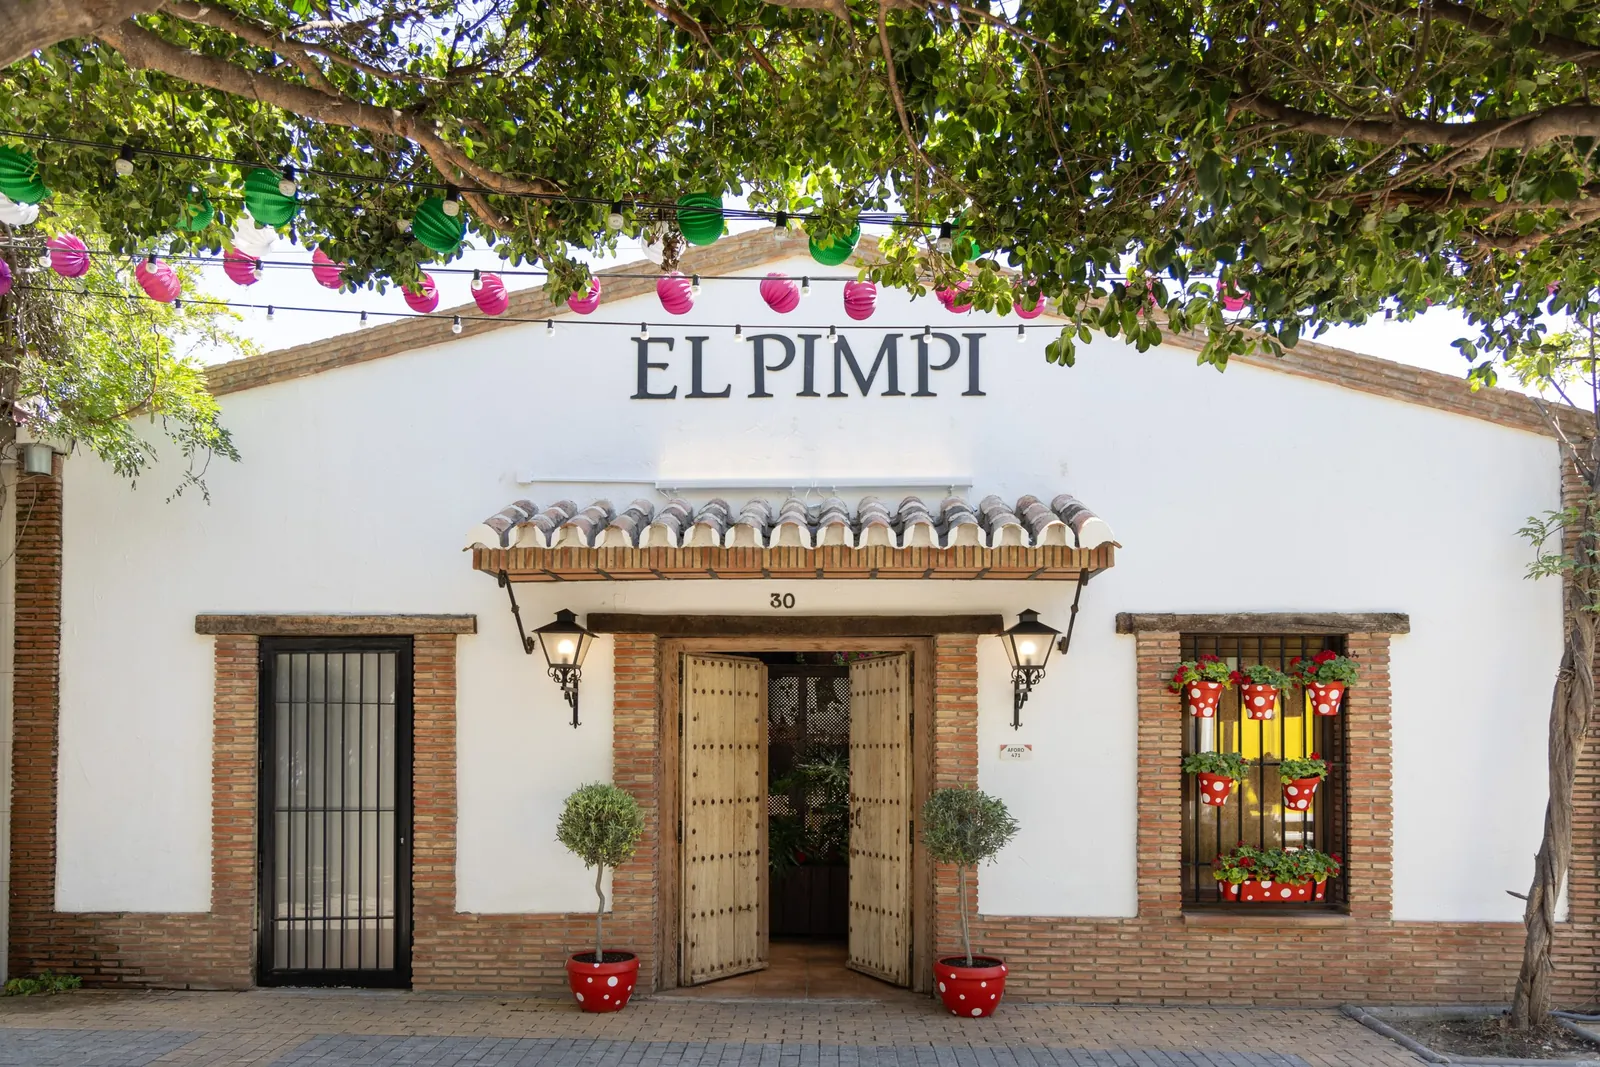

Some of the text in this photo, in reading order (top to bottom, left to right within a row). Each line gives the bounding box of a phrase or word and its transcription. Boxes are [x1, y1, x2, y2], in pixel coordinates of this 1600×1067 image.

[630, 333, 987, 400] EL PIMPI
[770, 593, 796, 609] 30
